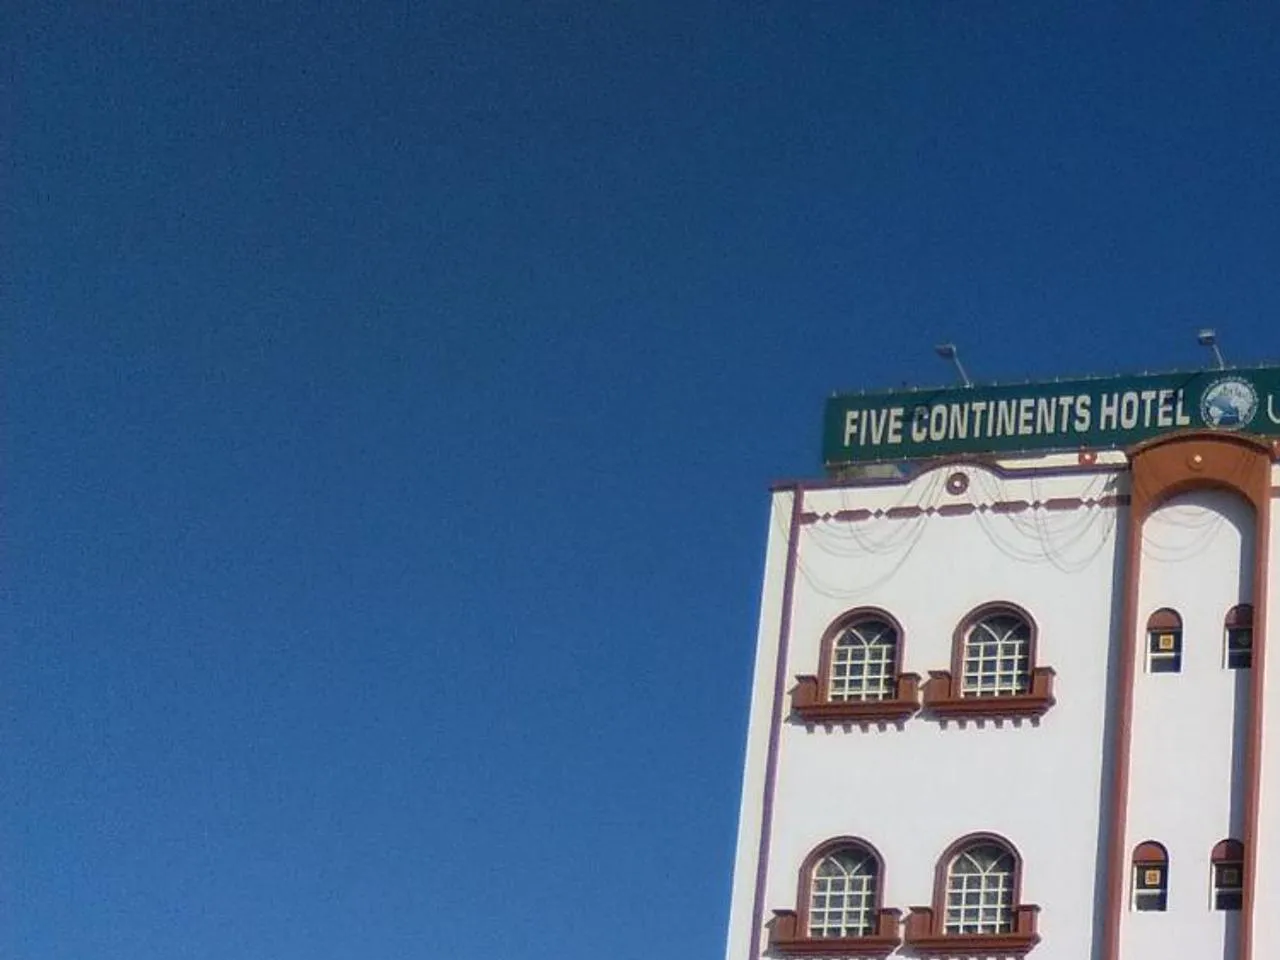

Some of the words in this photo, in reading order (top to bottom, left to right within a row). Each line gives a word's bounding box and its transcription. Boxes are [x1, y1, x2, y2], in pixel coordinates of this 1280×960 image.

[843, 407, 904, 447] FIVE
[911, 395, 1092, 444] CONTINENTS
[1099, 388, 1191, 432] HOTEL
